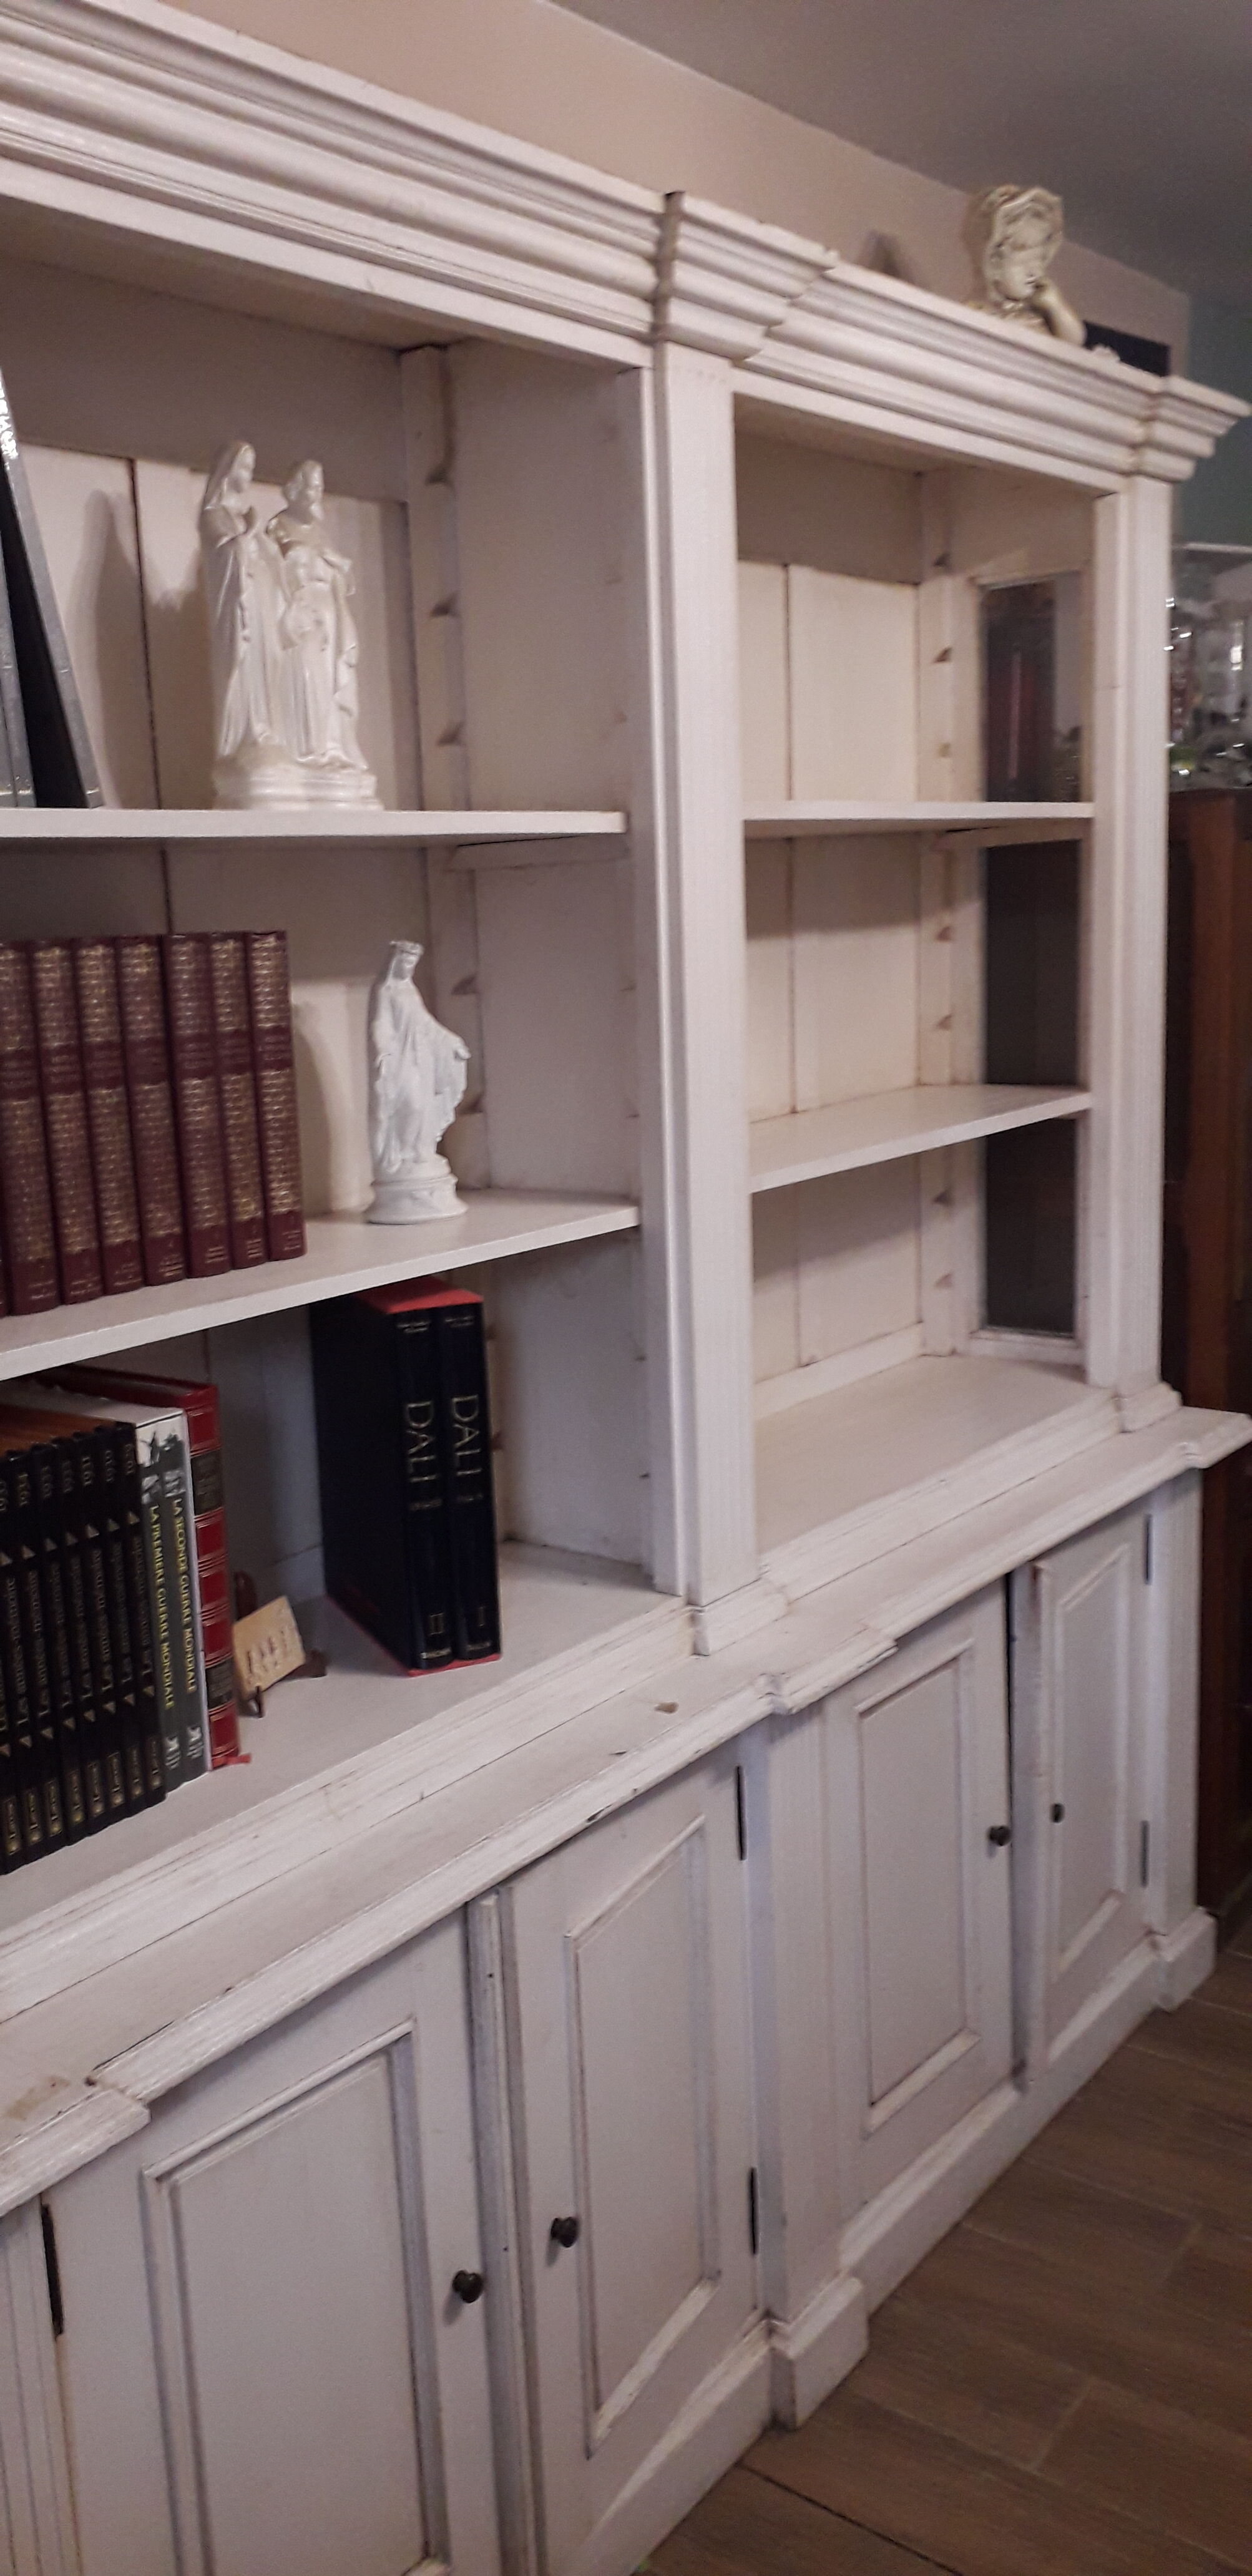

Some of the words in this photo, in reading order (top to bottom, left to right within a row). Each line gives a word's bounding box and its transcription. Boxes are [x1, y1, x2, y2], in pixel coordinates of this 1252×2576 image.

[150, 1505, 160, 1522] LA
[174, 1498, 183, 1515] LA
[175, 1517, 188, 1573] SECONDE
[157, 1587, 169, 1639] GUERRE
[180, 1574, 192, 1625] GUERRE
[161, 1642, 174, 1710] MONDIALE
[184, 1627, 197, 1694] MONDIALE
